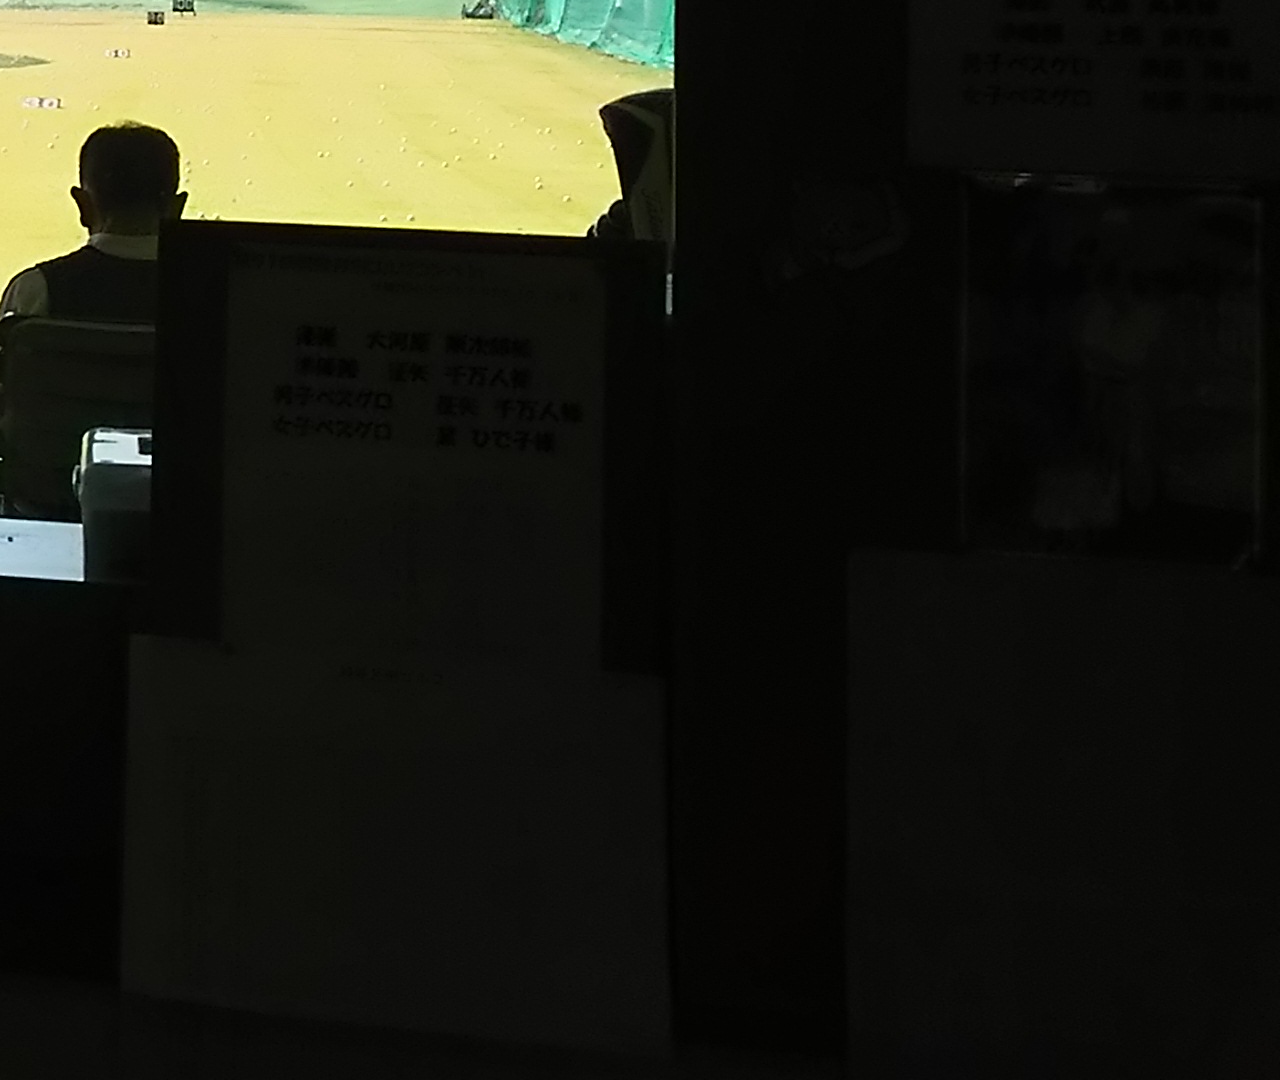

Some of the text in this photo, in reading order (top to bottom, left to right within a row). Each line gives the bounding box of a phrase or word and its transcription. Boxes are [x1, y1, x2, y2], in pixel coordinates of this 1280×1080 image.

[273, 384, 393, 411] 男子ベスグロ
[272, 415, 393, 441] 女子ベスグロ
